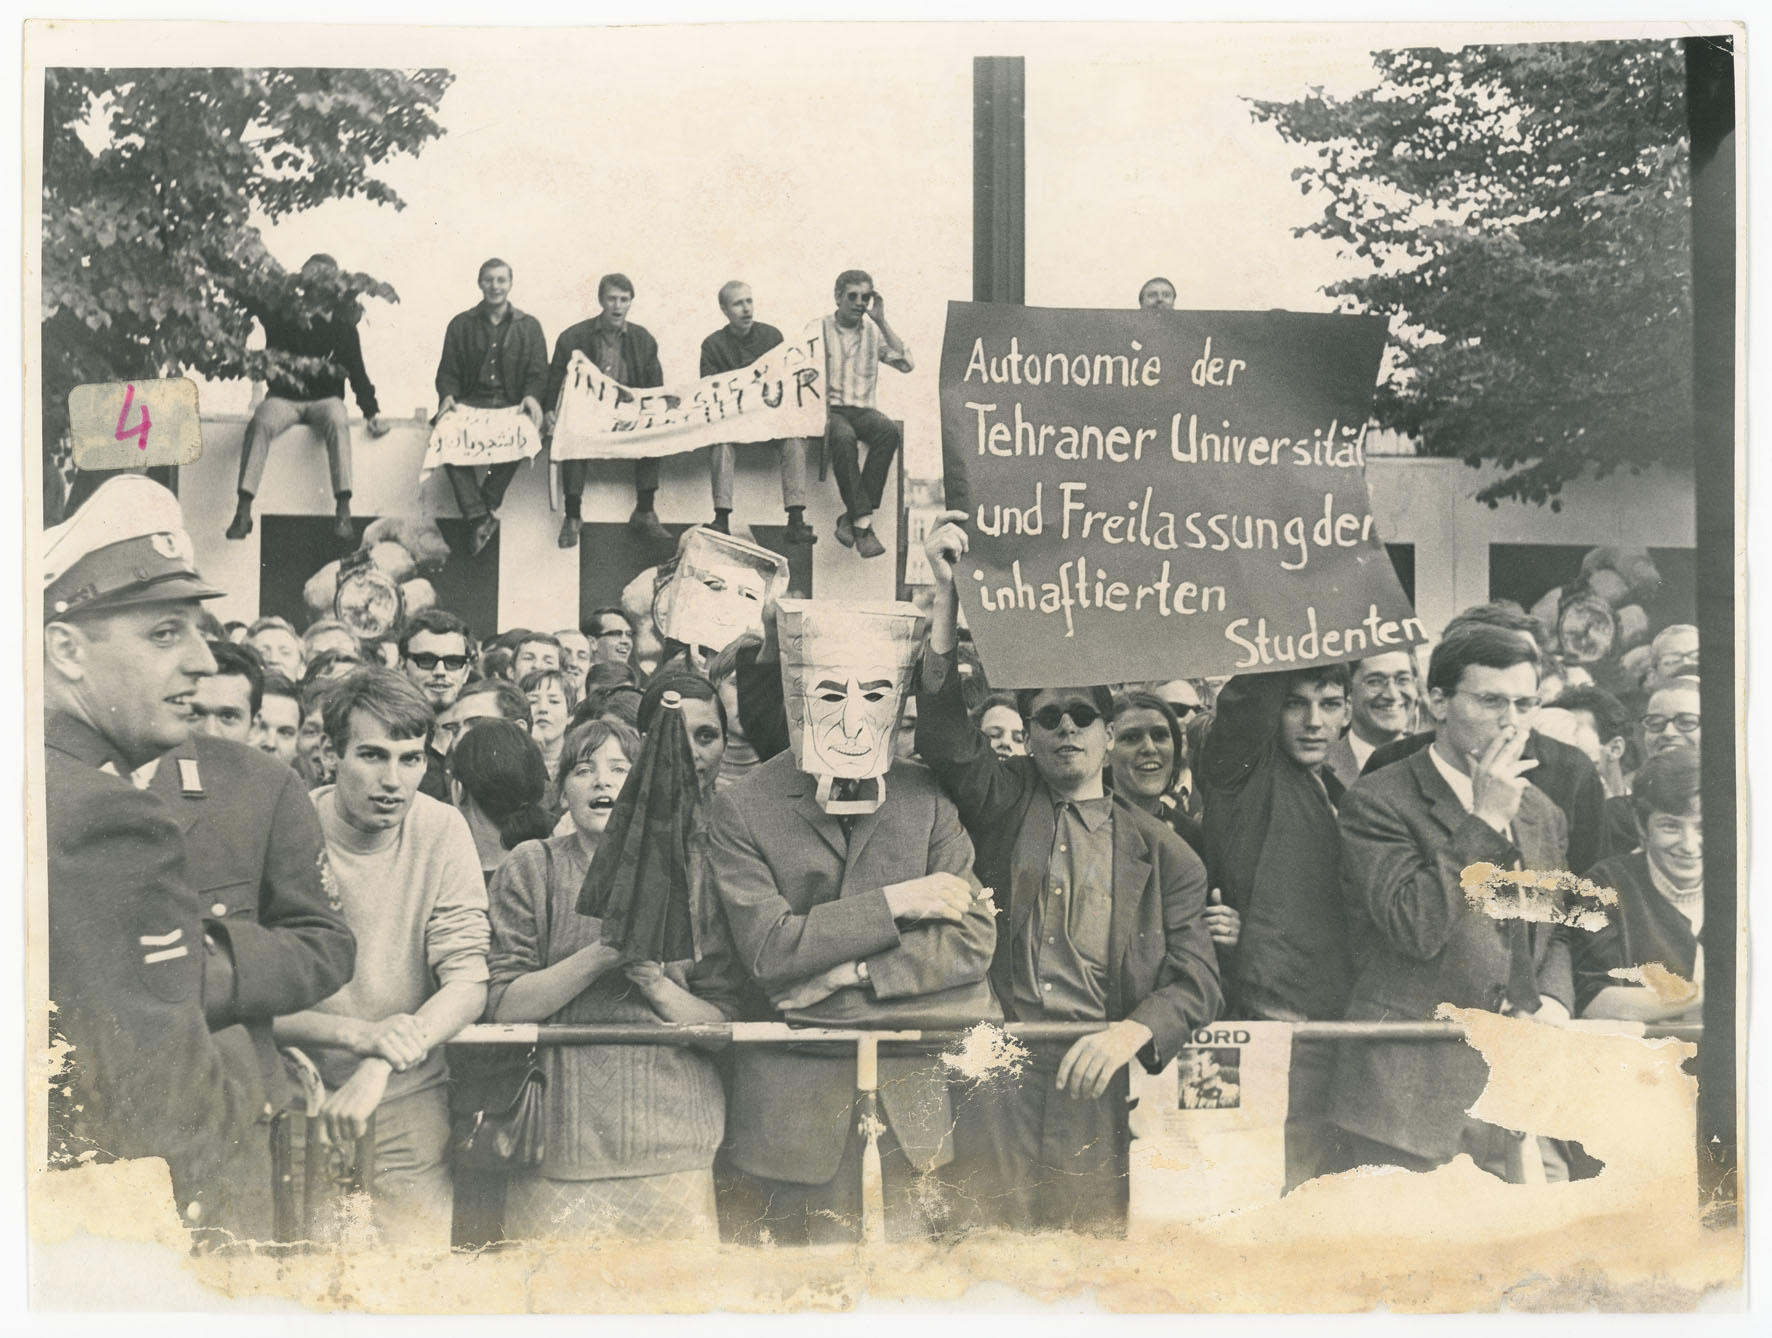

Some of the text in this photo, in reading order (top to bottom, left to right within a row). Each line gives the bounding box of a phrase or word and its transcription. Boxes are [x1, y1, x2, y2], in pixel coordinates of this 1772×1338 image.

[964, 336, 1246, 387] Autonomie der
[114, 383, 153, 451] 4
[964, 401, 1157, 461] Tehraner
[976, 481, 1375, 571] und Freilassung der
[972, 555, 1226, 638] inhaftierten
[1224, 603, 1430, 668] Studenten
[1191, 1030, 1251, 1044] ORD
